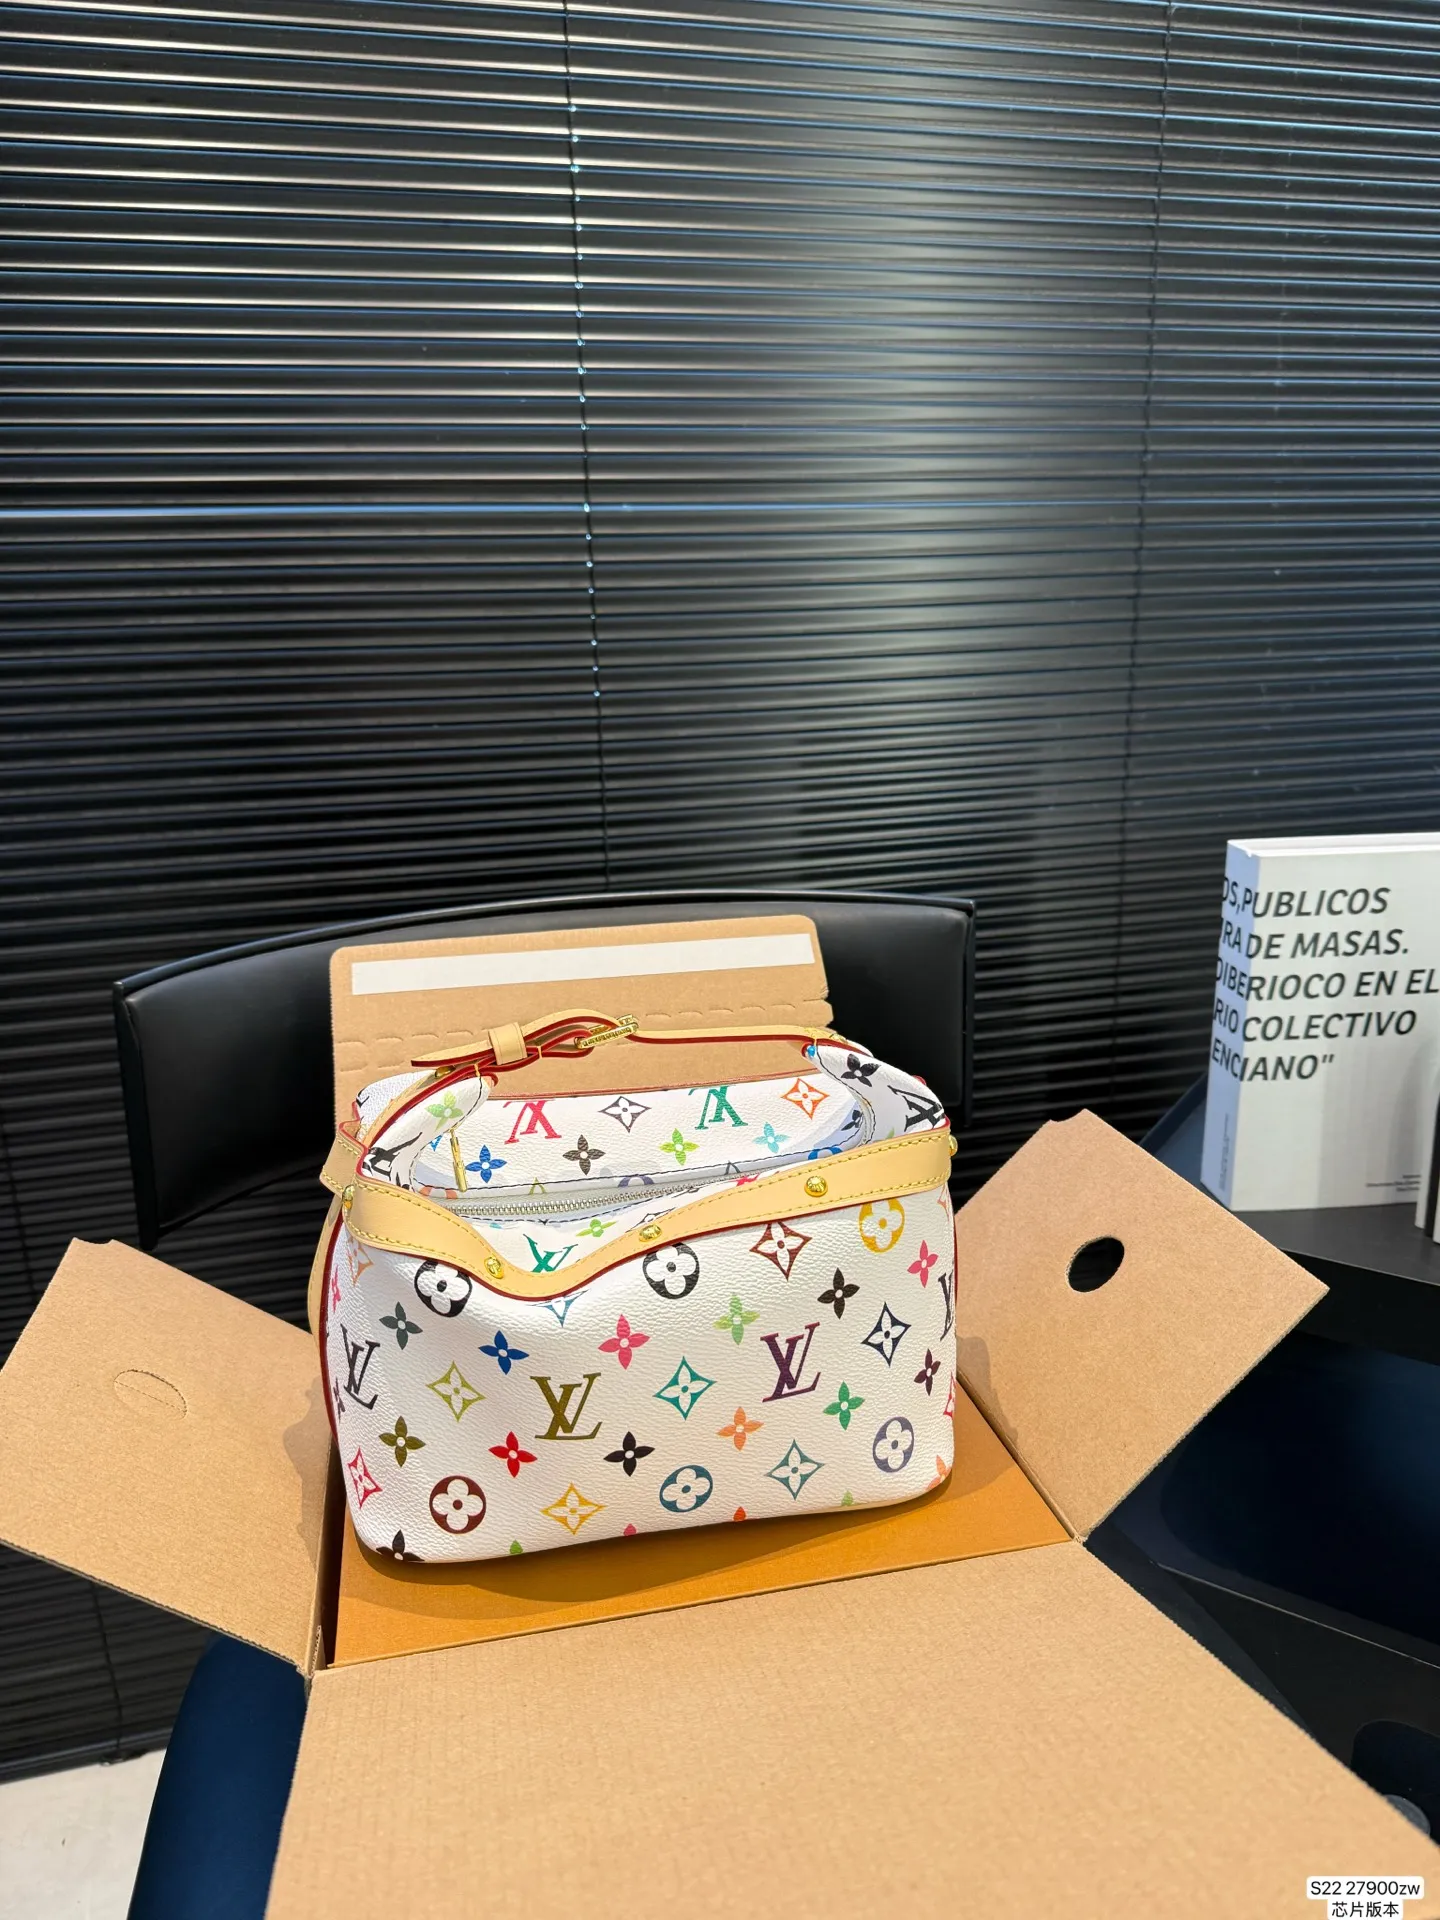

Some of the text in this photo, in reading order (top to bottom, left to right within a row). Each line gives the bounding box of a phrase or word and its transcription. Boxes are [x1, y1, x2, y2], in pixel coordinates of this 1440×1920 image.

[1220, 917, 1409, 960] RA DE MASAS.
[1353, 970, 1398, 997] EN
[1404, 968, 1440, 995] EL
[1242, 1009, 1417, 1043] COLECTIVO
[760, 1321, 821, 1403] LV
[530, 1372, 602, 1440] LV
